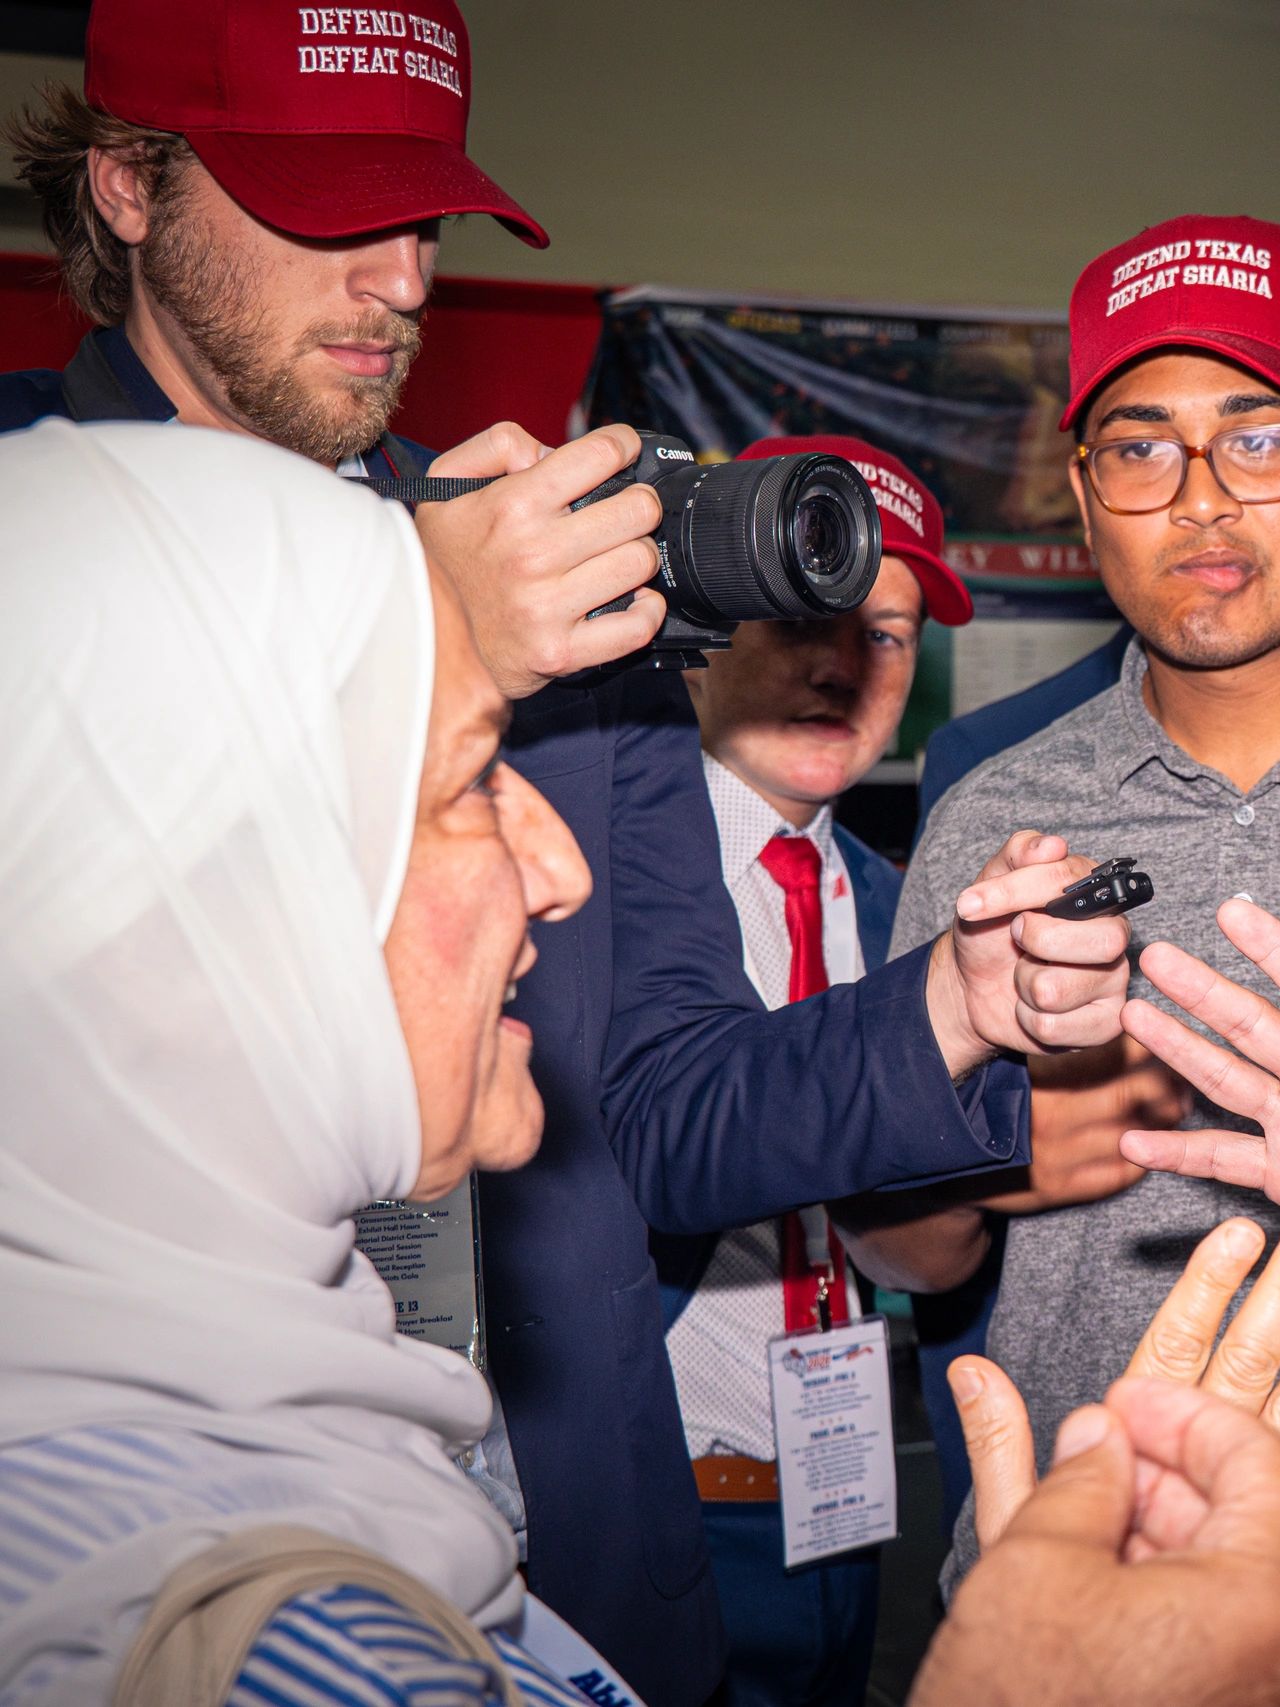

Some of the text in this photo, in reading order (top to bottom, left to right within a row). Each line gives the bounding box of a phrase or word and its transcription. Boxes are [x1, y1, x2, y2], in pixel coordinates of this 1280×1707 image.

[299, 8, 457, 57] DEFEND TEXAS
[298, 46, 462, 97] DEFEAT SHARIA
[1111, 240, 1271, 288] DEFEND TEXAS
[1106, 265, 1273, 317] DEFEAT SHARIA
[656, 447, 695, 461] Canon
[878, 467, 924, 513] TEXAS
[360, 1215, 397, 1225] Grassroots
[398, 1212, 415, 1221] Club
[416, 1209, 449, 1219] Brkfast
[358, 1222, 421, 1235] Exhibit Hall Hours
[381, 1233, 405, 1243] District
[406, 1230, 439, 1240] Caucuses
[365, 1245, 395, 1254] General
[396, 1243, 422, 1252] Session
[396, 1253, 422, 1262] Session
[391, 1261, 426, 1272] Reception
[401, 1272, 419, 1280] Gala
[407, 1300, 419, 1312] 13
[420, 1315, 453, 1324] Breakfast
[404, 1327, 425, 1335] Hours
